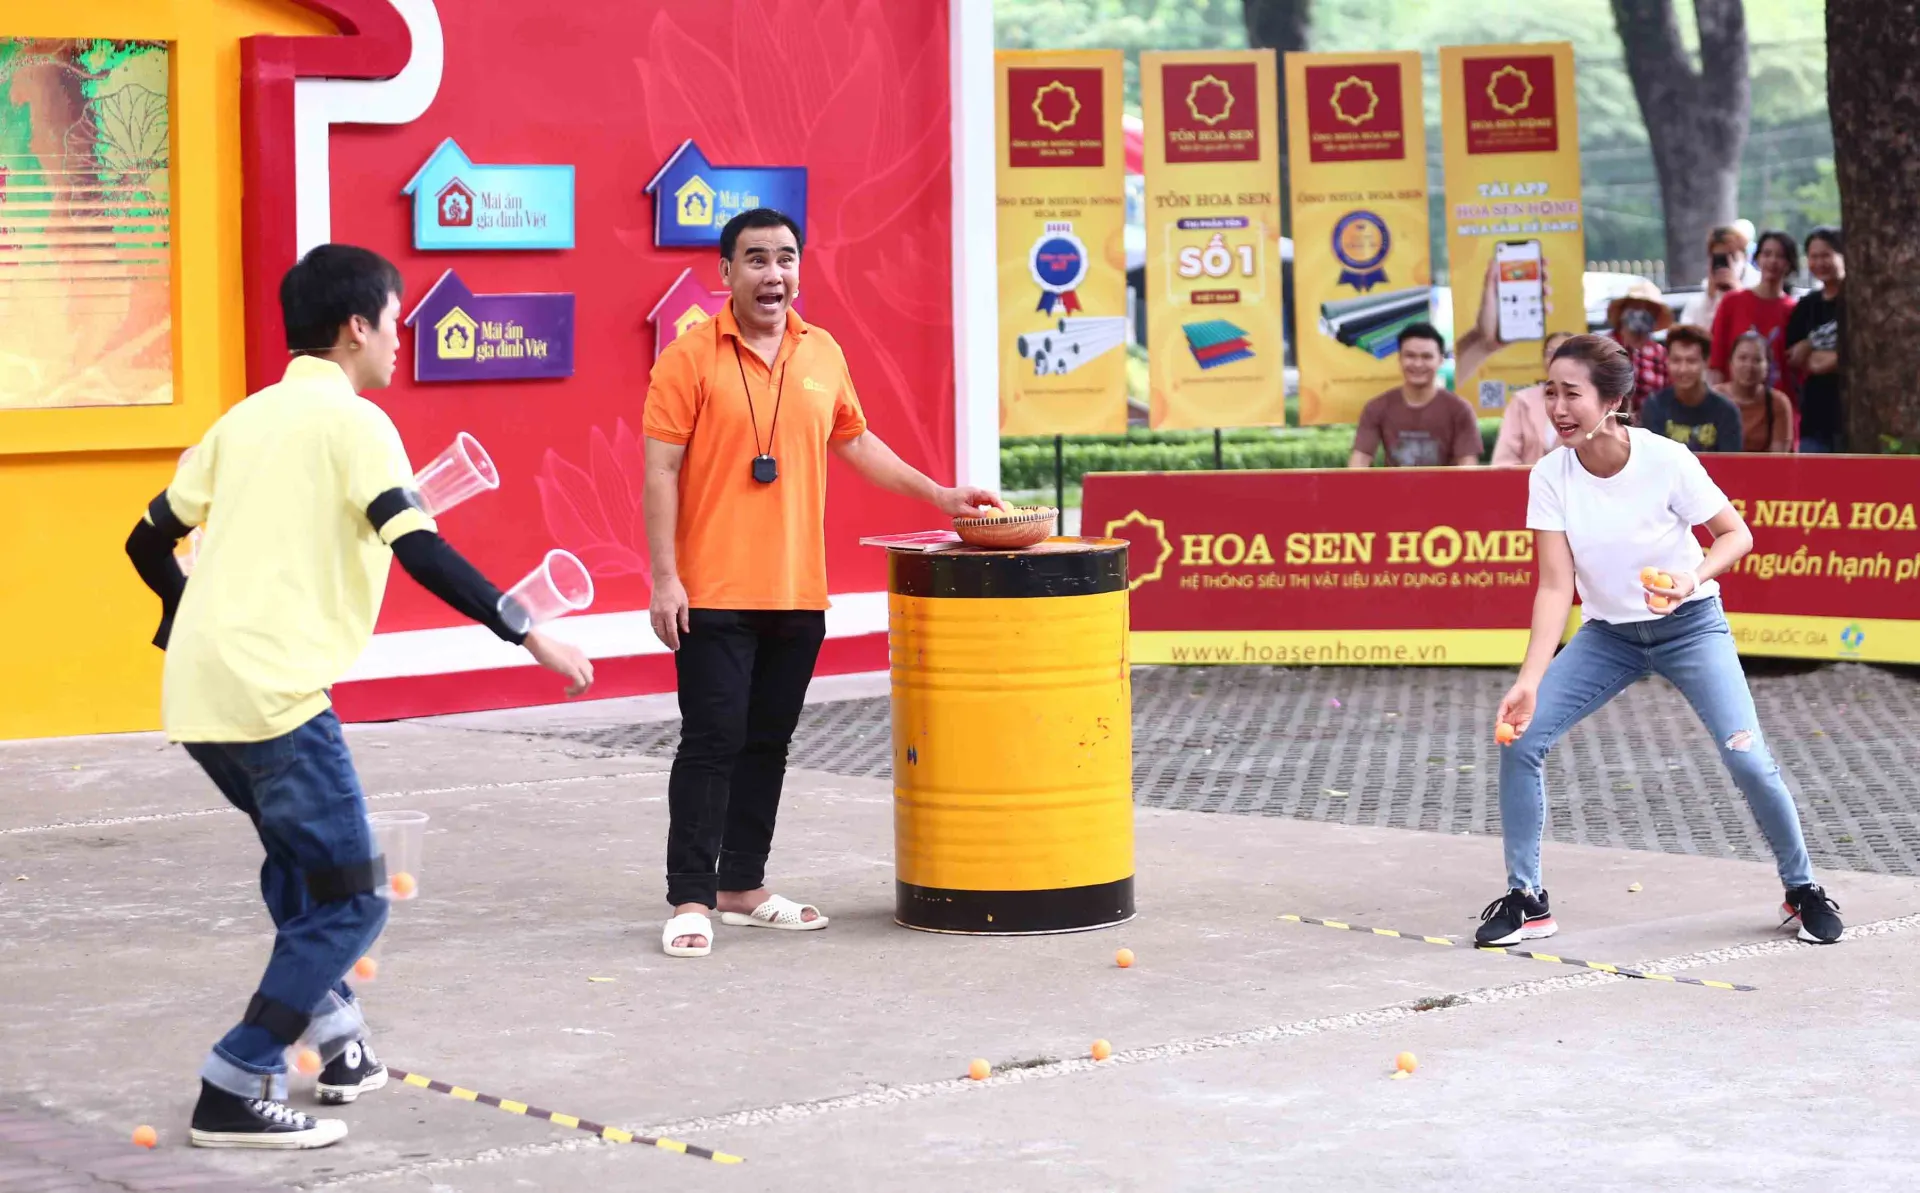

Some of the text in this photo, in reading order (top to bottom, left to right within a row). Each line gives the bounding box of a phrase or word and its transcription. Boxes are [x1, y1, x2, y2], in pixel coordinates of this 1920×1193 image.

[1197, 130, 1226, 141] HOA
[1228, 129, 1254, 140] SEN
[1155, 189, 1271, 208] TÔN HOA SEN
[1513, 182, 1549, 196] APP
[1456, 204, 1490, 218] HOA
[1492, 203, 1524, 216] SEN
[1178, 232, 1253, 278] SỐ 1
[476, 341, 494, 363] gia
[525, 338, 548, 360] Việt
[1752, 498, 1841, 535] NHỰA
[1847, 501, 1918, 531] HOA
[1179, 525, 1534, 568] HOA SEN HOME
[1743, 544, 1823, 580] nguồn
[1826, 549, 1891, 584] hạnh
[1180, 572, 1199, 591] HỆ
[1202, 571, 1254, 589] THỐNG
[1257, 570, 1286, 588] SIÊU
[1289, 573, 1311, 590] THỊ
[1373, 570, 1400, 587] XÂY
[1403, 571, 1447, 590] DỰNG
[1451, 571, 1461, 587] &
[1465, 569, 1494, 588] NỘI
[1171, 639, 1448, 662] www.hoasenhome.vn
